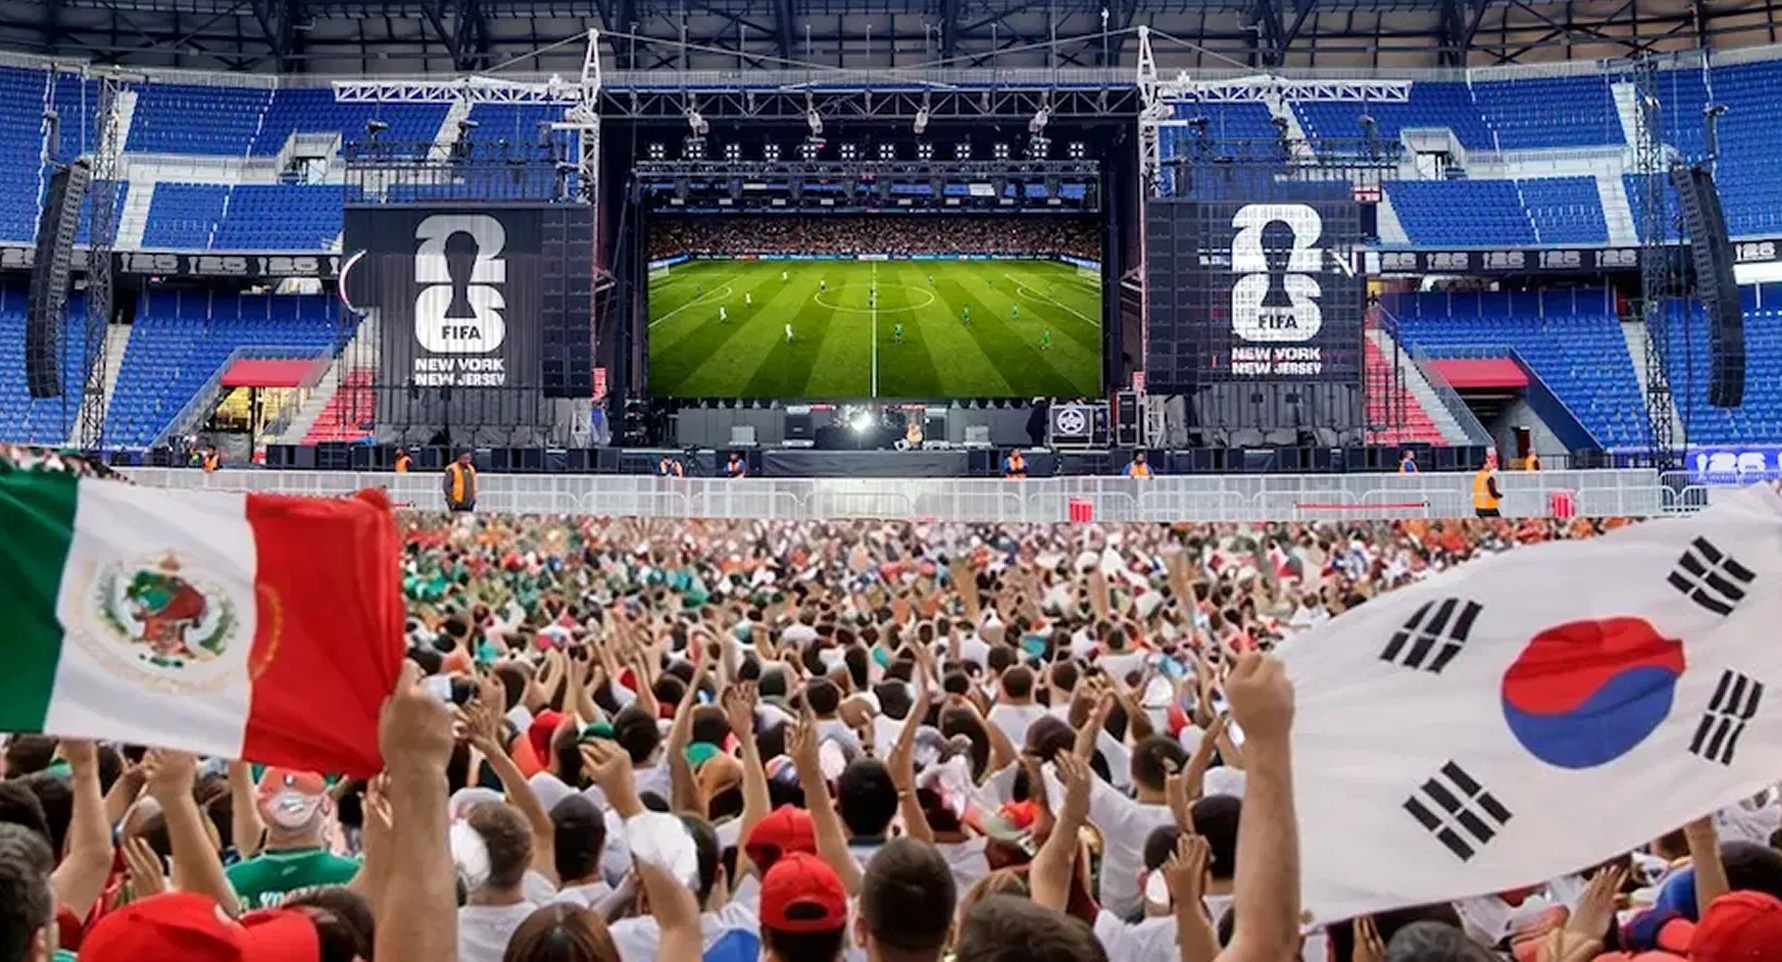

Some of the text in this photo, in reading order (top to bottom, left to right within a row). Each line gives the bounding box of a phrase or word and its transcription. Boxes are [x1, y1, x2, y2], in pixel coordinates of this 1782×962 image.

[1258, 314, 1298, 329] FIFA
[442, 325, 481, 340] FIFA
[1231, 347, 1321, 361] NEW YORK
[415, 358, 505, 371] NEW YORK
[1231, 361, 1322, 375] NEW JERSEY
[415, 372, 506, 386] NEW JERSEY
